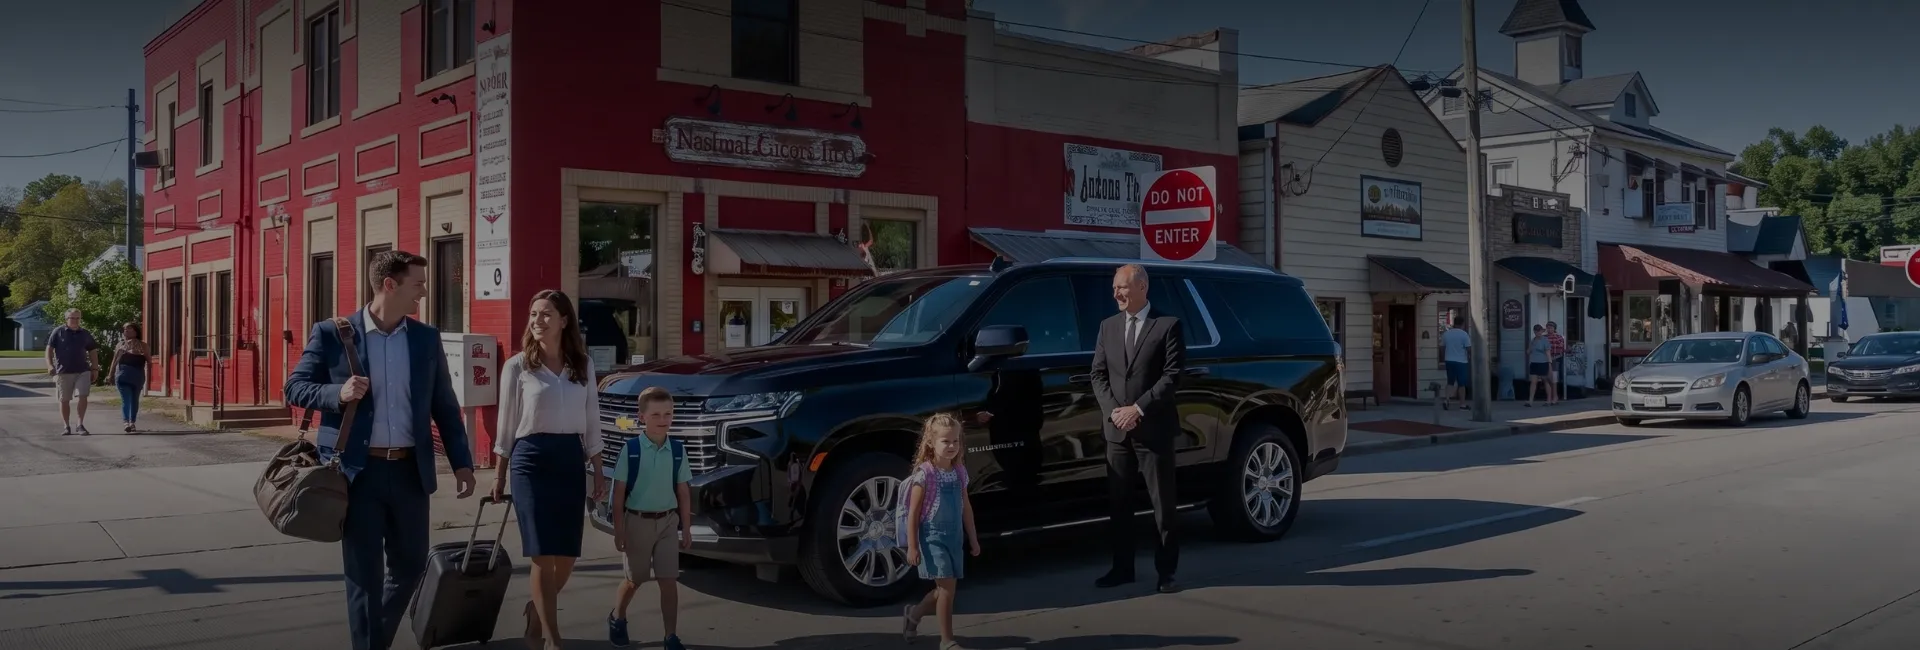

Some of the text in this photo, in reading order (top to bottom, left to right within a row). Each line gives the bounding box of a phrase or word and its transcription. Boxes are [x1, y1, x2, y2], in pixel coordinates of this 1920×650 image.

[1151, 186, 1205, 205] DO NOT
[1155, 227, 1200, 244] ENTER
